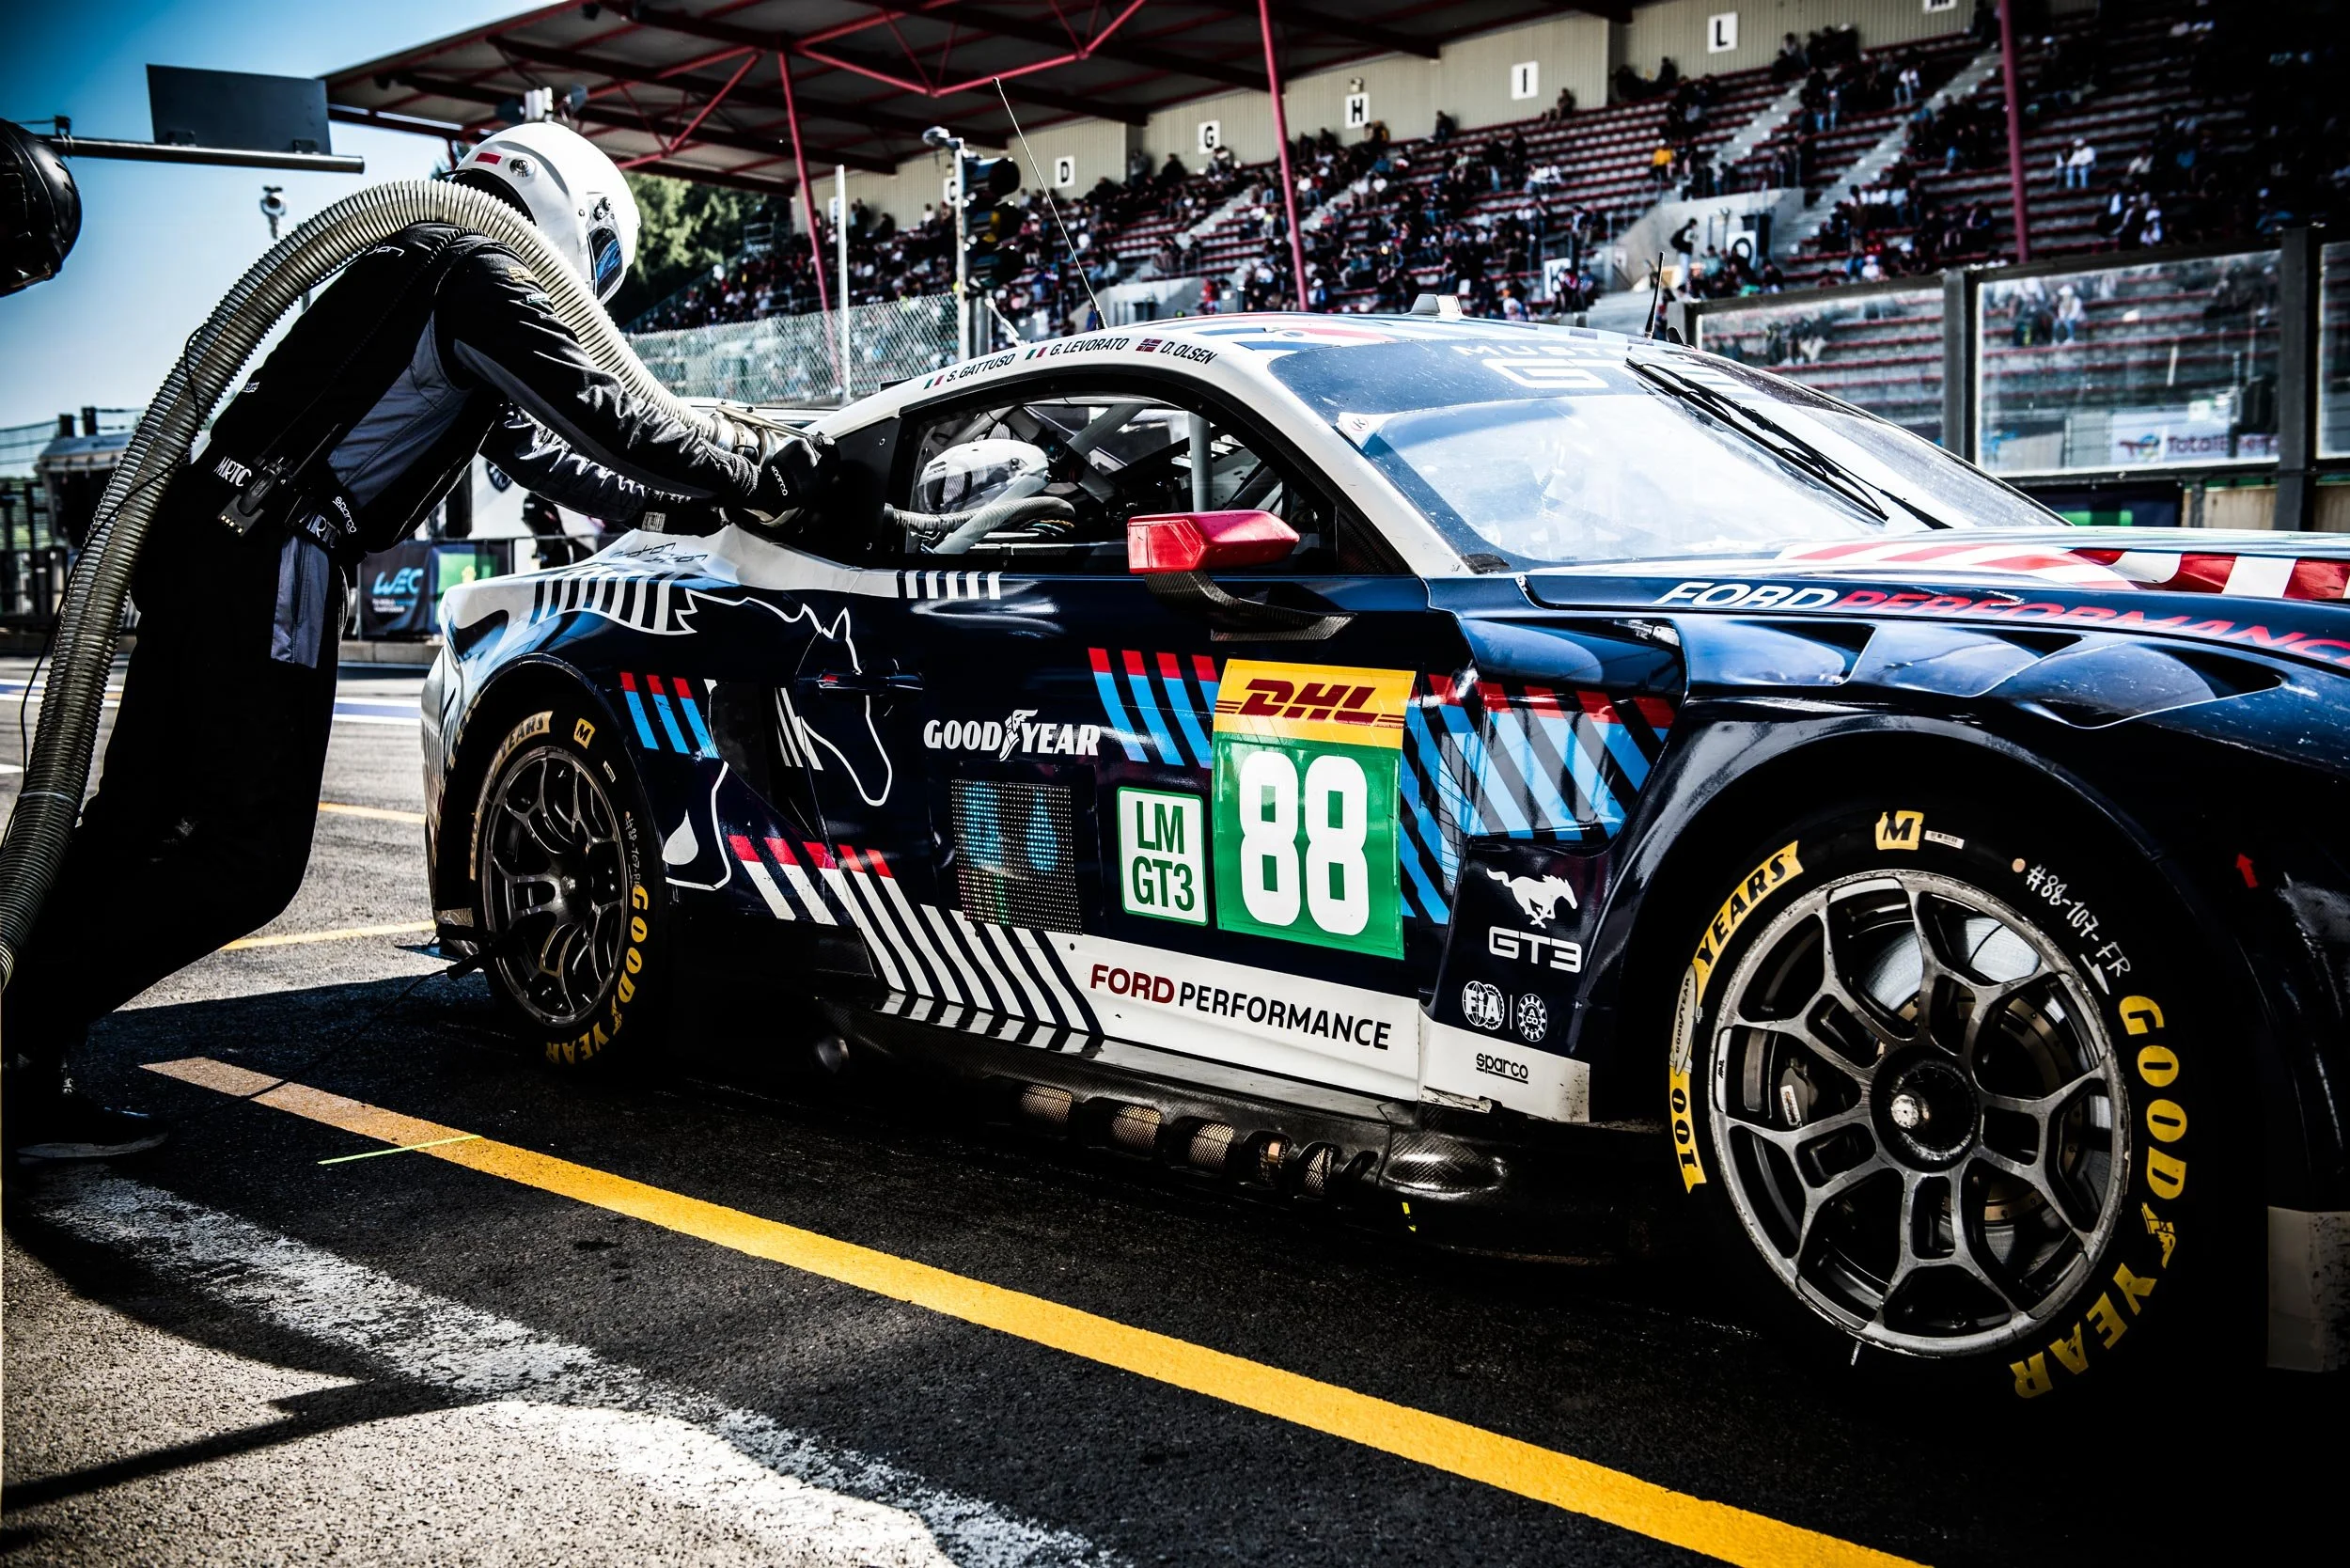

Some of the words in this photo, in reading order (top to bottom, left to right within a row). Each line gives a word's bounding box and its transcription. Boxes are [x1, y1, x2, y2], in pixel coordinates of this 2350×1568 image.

[1716, 20, 1728, 46] L
[1352, 99, 1363, 123] H
[1204, 125, 1214, 149] G
[1059, 160, 1070, 183] D
[1050, 343, 1061, 356] G.
[1063, 337, 1130, 353] LEVORATO
[1159, 340, 1172, 354] D.
[1174, 343, 1218, 365] OLSEN
[946, 370, 958, 383] S.
[959, 353, 1016, 379] GATTUSO
[333, 495, 357, 535] sparco
[372, 567, 424, 595] WEC
[1652, 582, 1840, 611] FORD
[1238, 678, 1379, 724] DHL
[576, 724, 591, 742] M
[1136, 801, 1184, 855] LM
[1882, 813, 1916, 840] M
[1239, 750, 1370, 936] 88
[1132, 855, 1195, 912] GT3
[1489, 925, 1582, 974] GT3
[1090, 964, 1175, 1004] FORD
[1179, 981, 1392, 1051] PERFORMANCE
[1672, 1088, 1698, 1168] 100
[1696, 853, 1785, 966] YEARS
[1476, 1052, 1528, 1083] sparco
